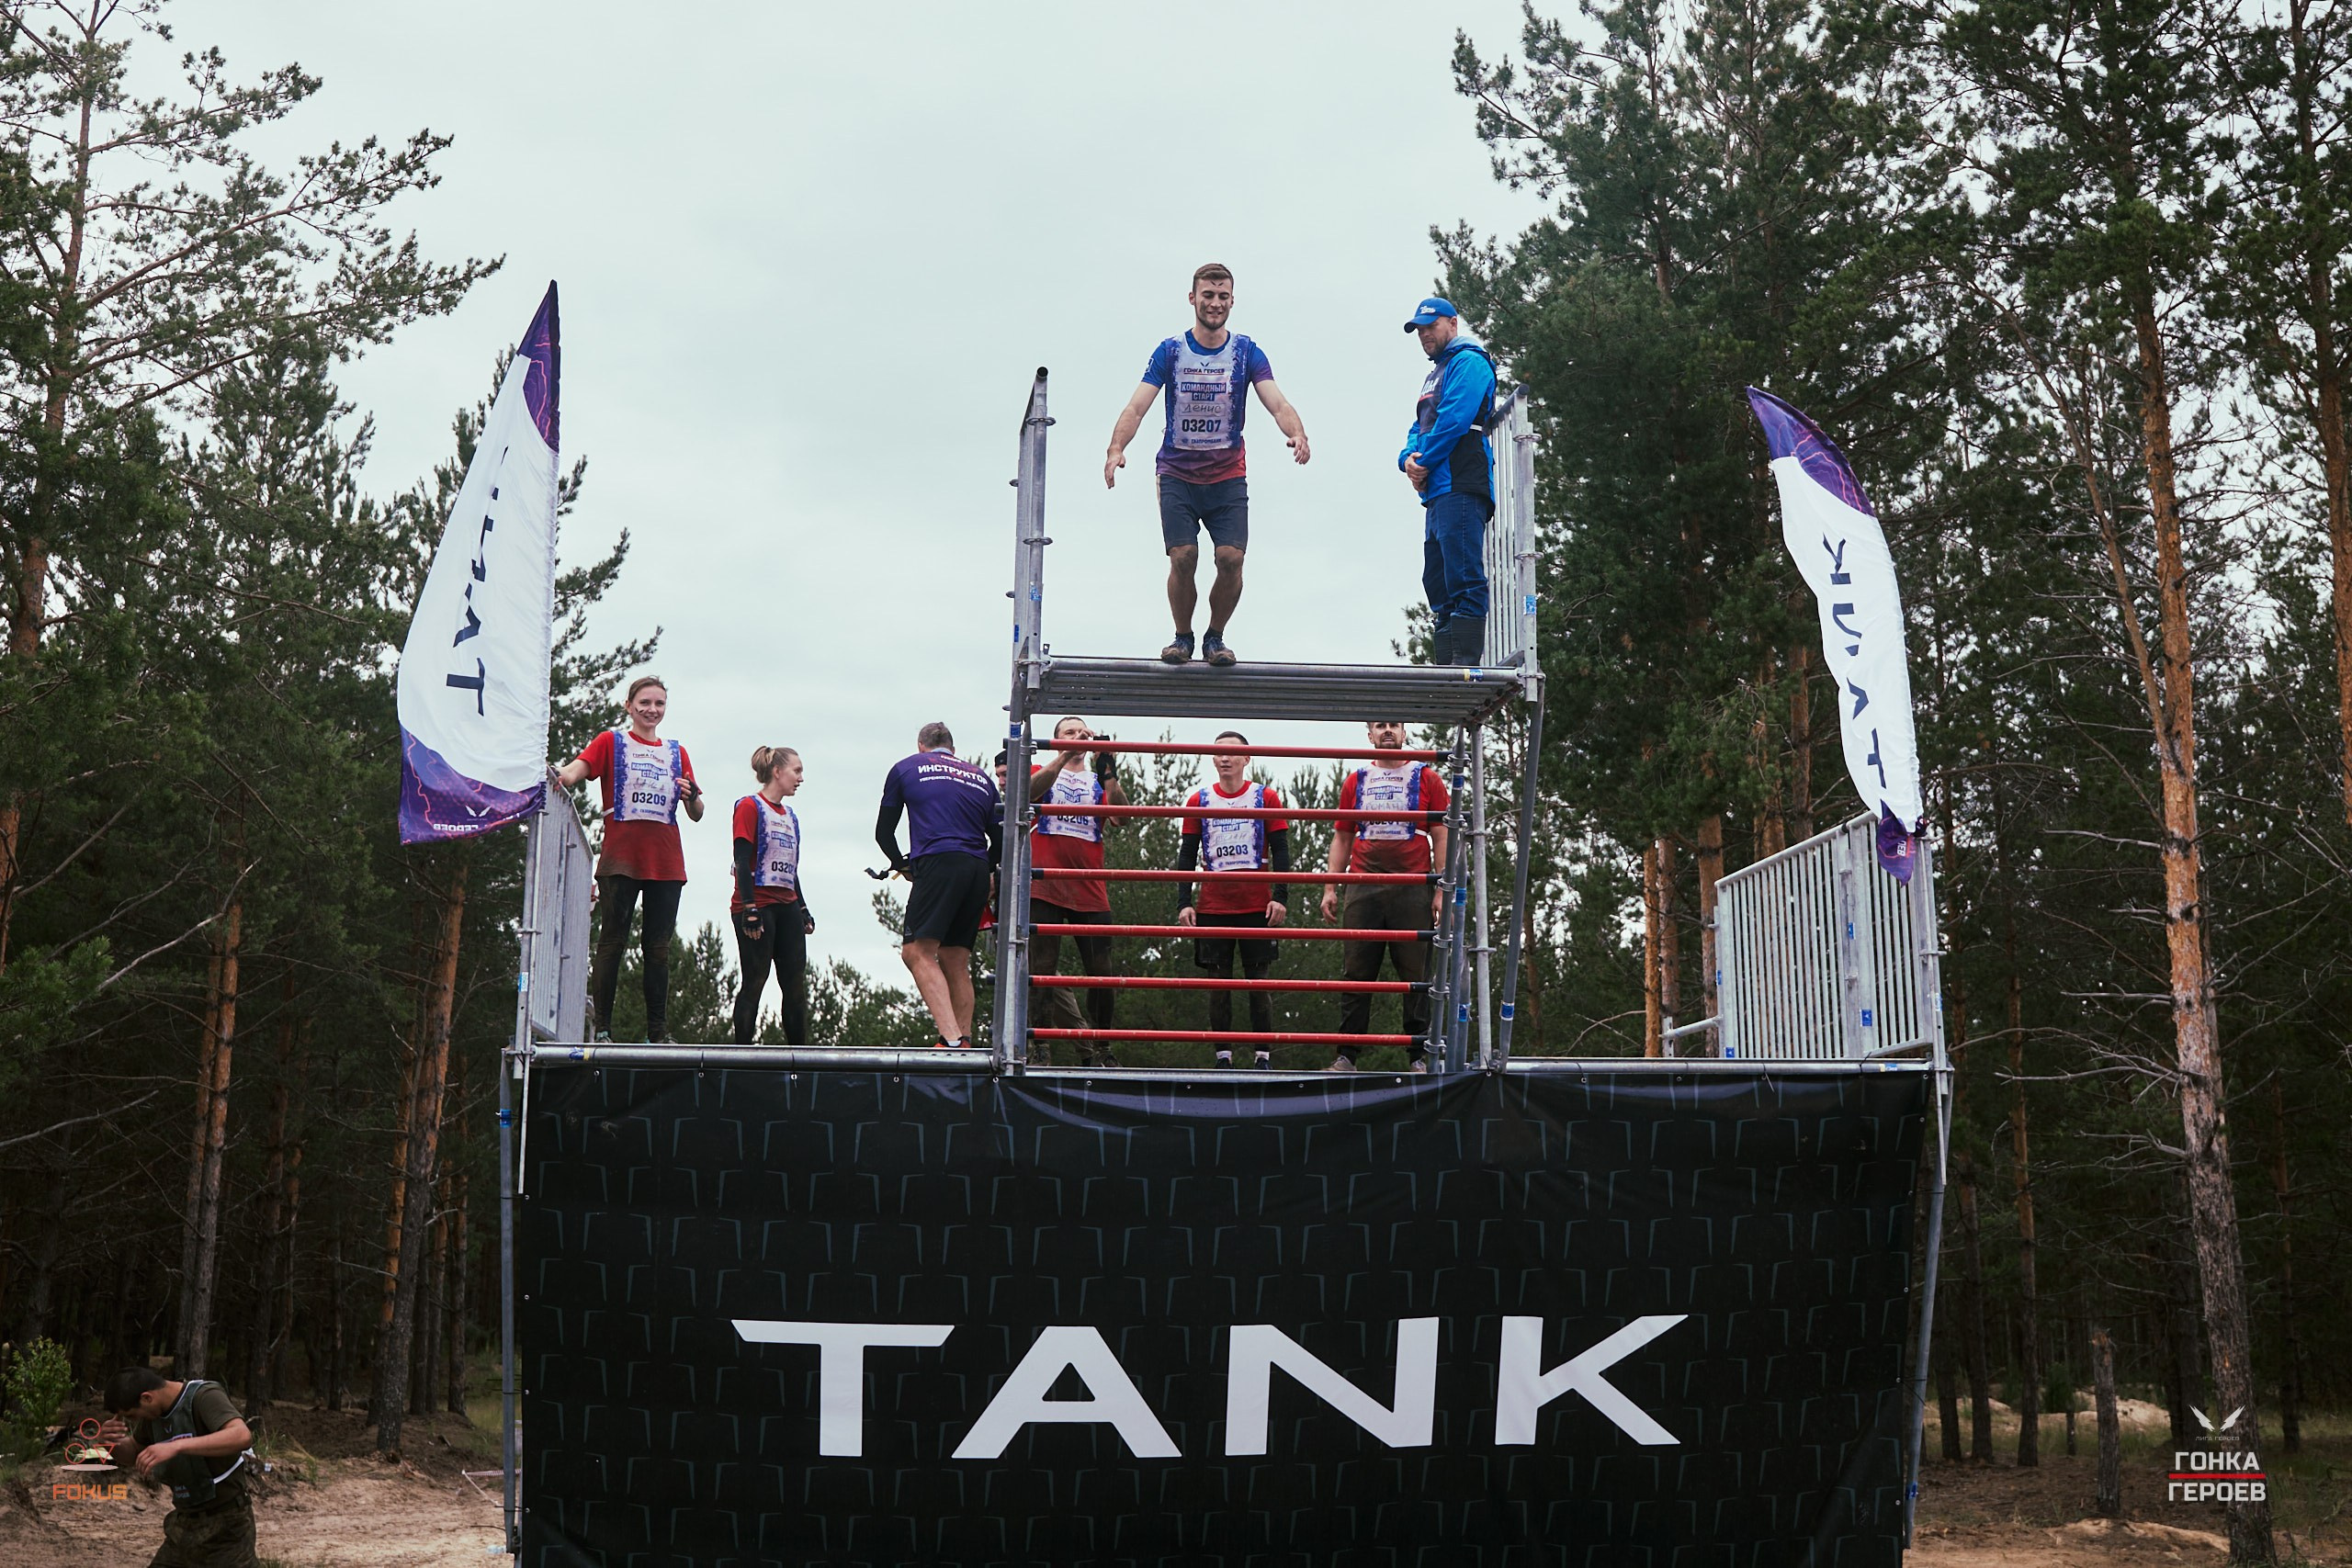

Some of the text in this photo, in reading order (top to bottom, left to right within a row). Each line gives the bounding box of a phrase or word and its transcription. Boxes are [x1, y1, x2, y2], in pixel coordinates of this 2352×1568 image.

[1182, 382, 1226, 393] КОМАНДНЫЙ
[1182, 419, 1221, 433] 03207
[918, 764, 988, 785] ИНСТРУКТОР
[632, 792, 666, 806] 03209
[1216, 844, 1249, 857] 03203
[731, 1315, 1689, 1459] TANK
